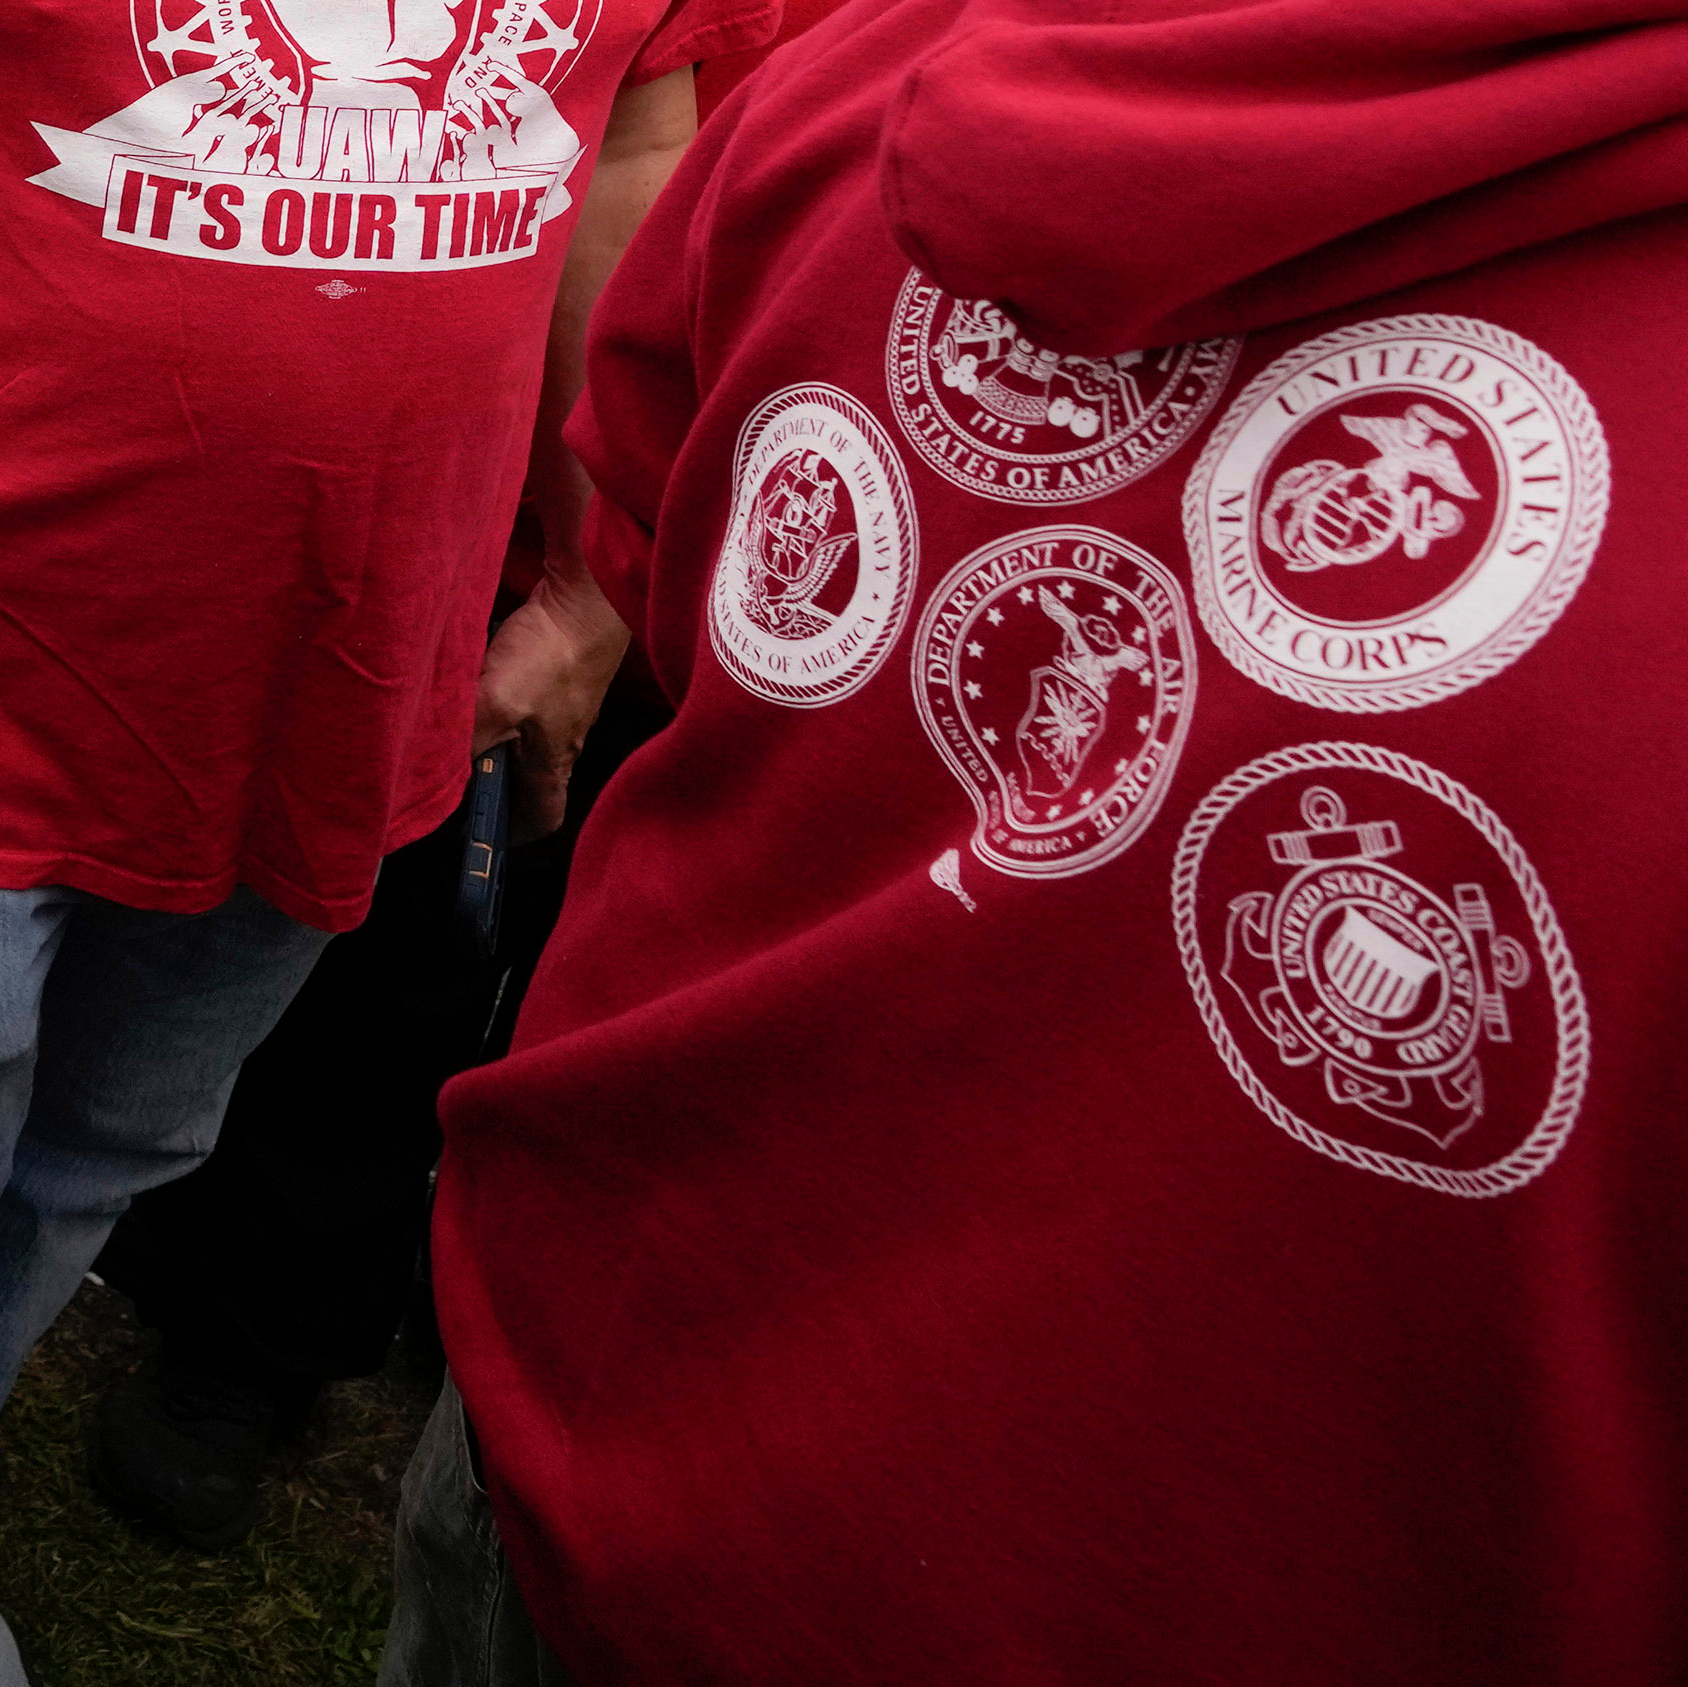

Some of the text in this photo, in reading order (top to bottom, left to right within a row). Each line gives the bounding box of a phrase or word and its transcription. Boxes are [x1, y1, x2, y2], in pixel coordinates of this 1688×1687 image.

[278, 105, 450, 182] UAW
[116, 168, 548, 261] IT'S OUR TIME
[899, 285, 1193, 490] UNITED STATES OF AMERICA
[969, 410, 1027, 445] 1775
[748, 417, 892, 580] DEPARTMENT OF THE NAVY
[1275, 346, 1563, 564] UNITED STATES
[1216, 488, 1450, 673] MARINE CORPS
[720, 608, 876, 676] STATES OF AMERICA
[927, 542, 1060, 687] DEPARTMENT
[1071, 543, 1119, 576] OF
[1132, 570, 1176, 638] THE
[1157, 657, 1184, 714] AIR
[941, 715, 989, 783] UNITED
[1280, 883, 1325, 980] UNITED
[1318, 870, 1421, 915] STATES
[1416, 908, 1474, 1006] COAST
[1305, 1004, 1373, 1059] 1790
[1395, 1003, 1473, 1064] GUARD
